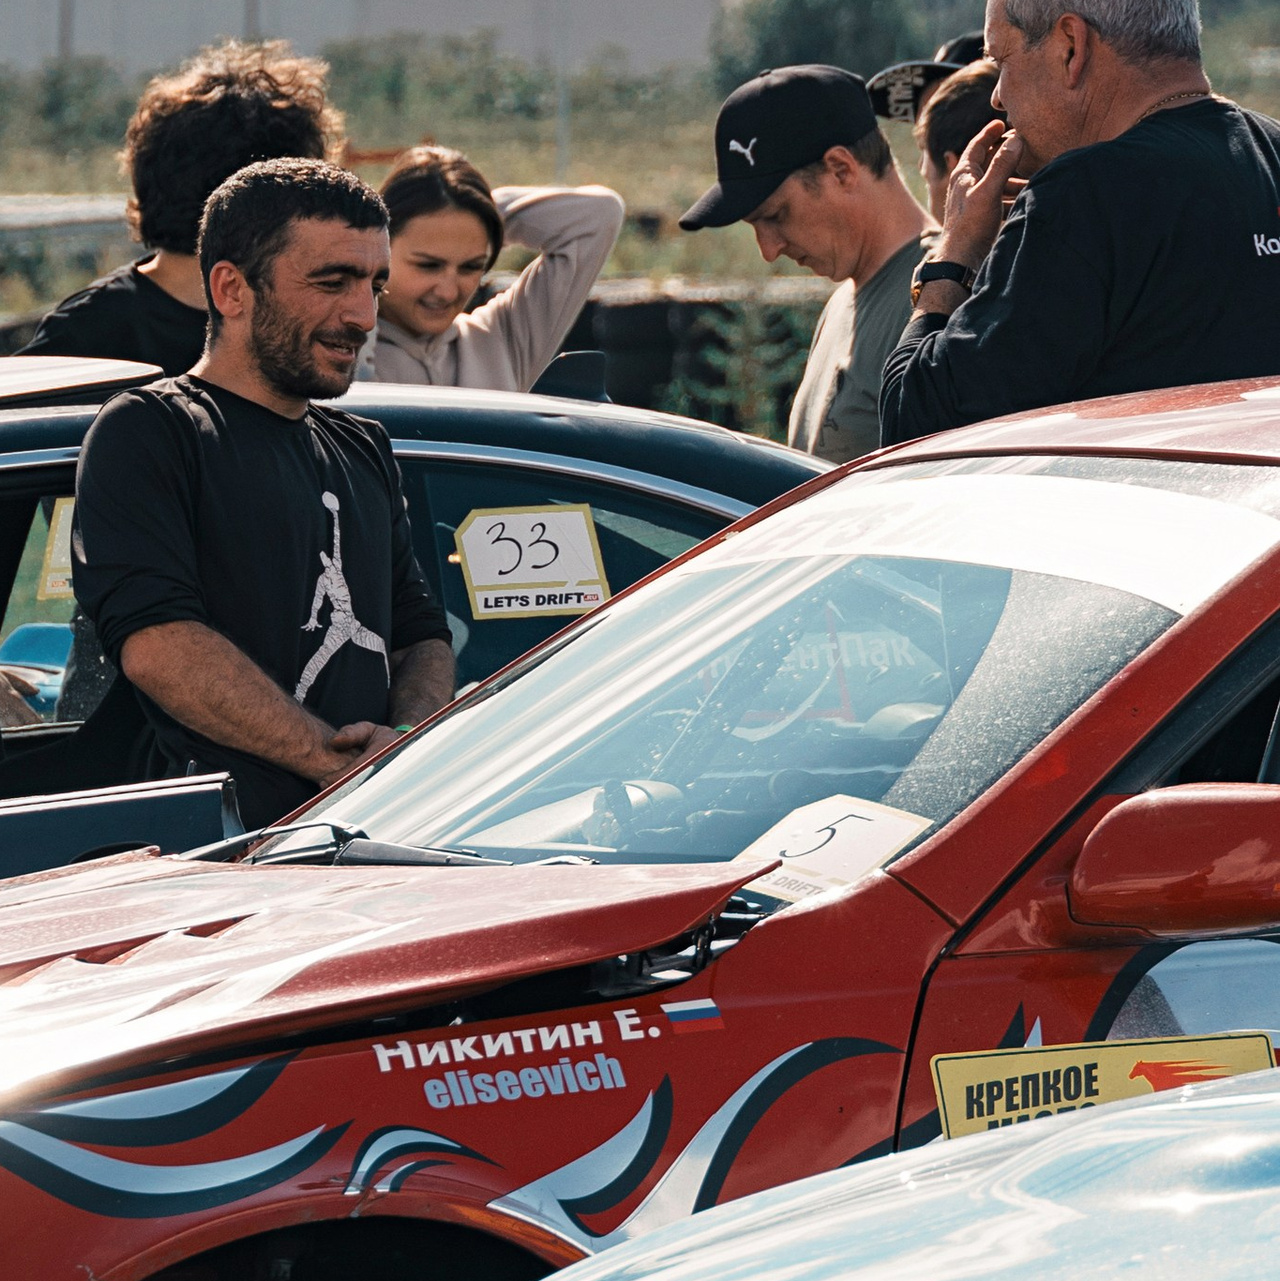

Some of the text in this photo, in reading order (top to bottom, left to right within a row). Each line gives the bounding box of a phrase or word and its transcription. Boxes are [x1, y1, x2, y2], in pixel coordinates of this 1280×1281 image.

[1253, 233, 1280, 256] Ко
[486, 522, 559, 576] 33
[483, 594, 530, 609] LET'S
[779, 814, 874, 858] 5
[771, 876, 824, 896] DRIFT
[423, 1053, 626, 1109] eliseevich
[965, 1062, 1099, 1120] КРЕПКОЕ
